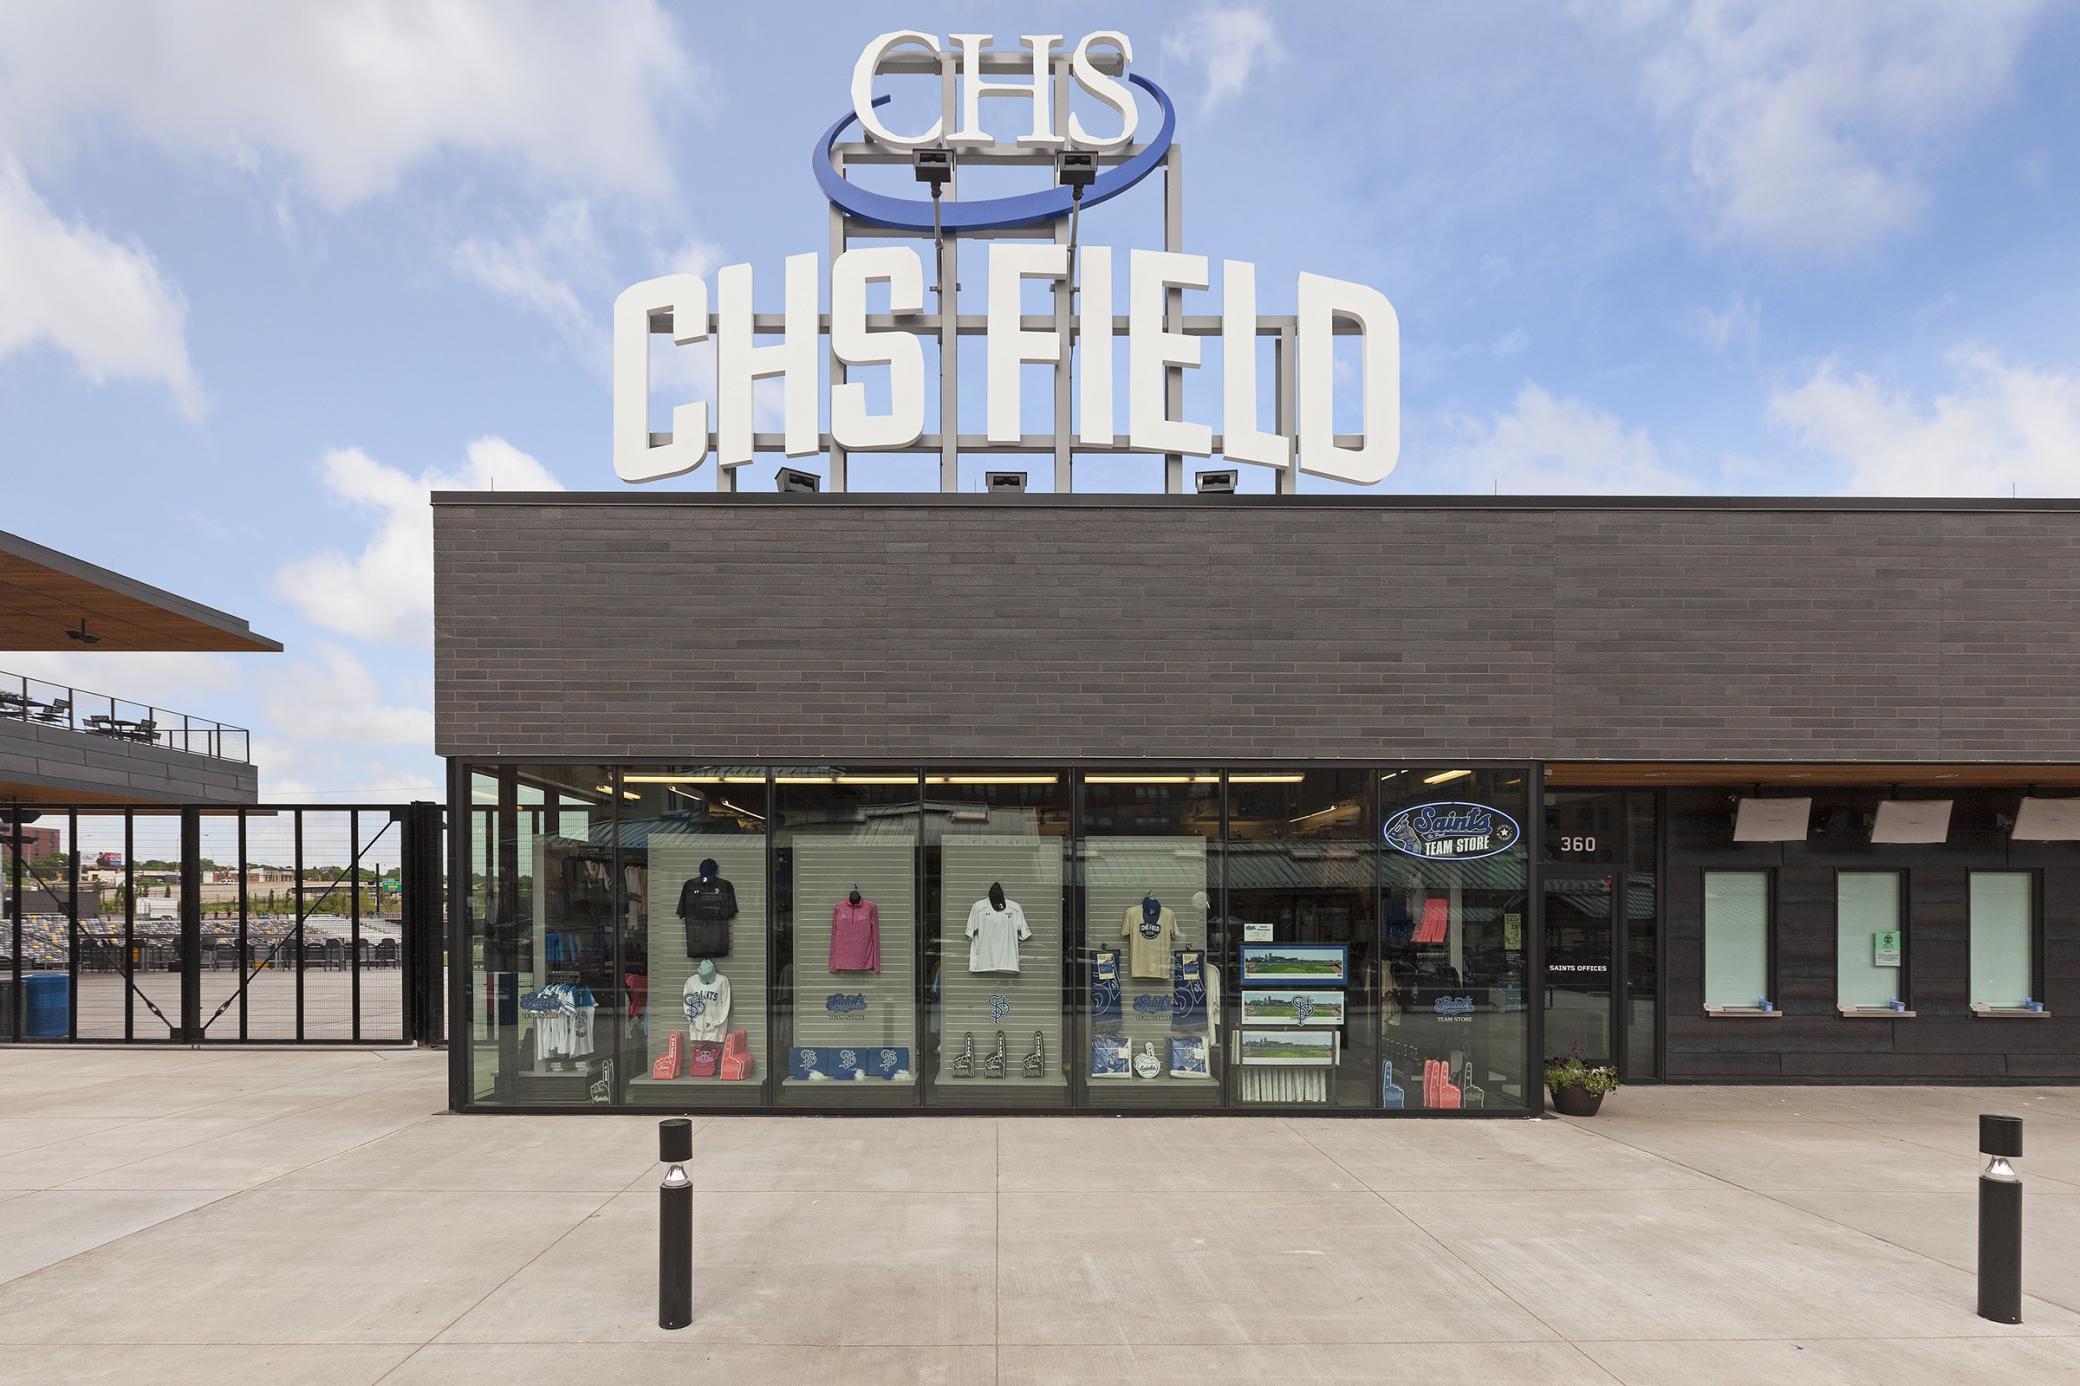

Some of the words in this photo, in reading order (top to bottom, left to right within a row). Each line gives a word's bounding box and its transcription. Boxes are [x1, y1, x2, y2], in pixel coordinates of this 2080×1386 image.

[850, 29, 1138, 152] CHS
[613, 245, 925, 484] CHS
[987, 243, 1400, 486] FIELD
[1413, 807, 1492, 836] Saints
[1425, 840, 1453, 856] TEAM
[1456, 836, 1489, 853] STORE
[1560, 836, 1596, 852] 360
